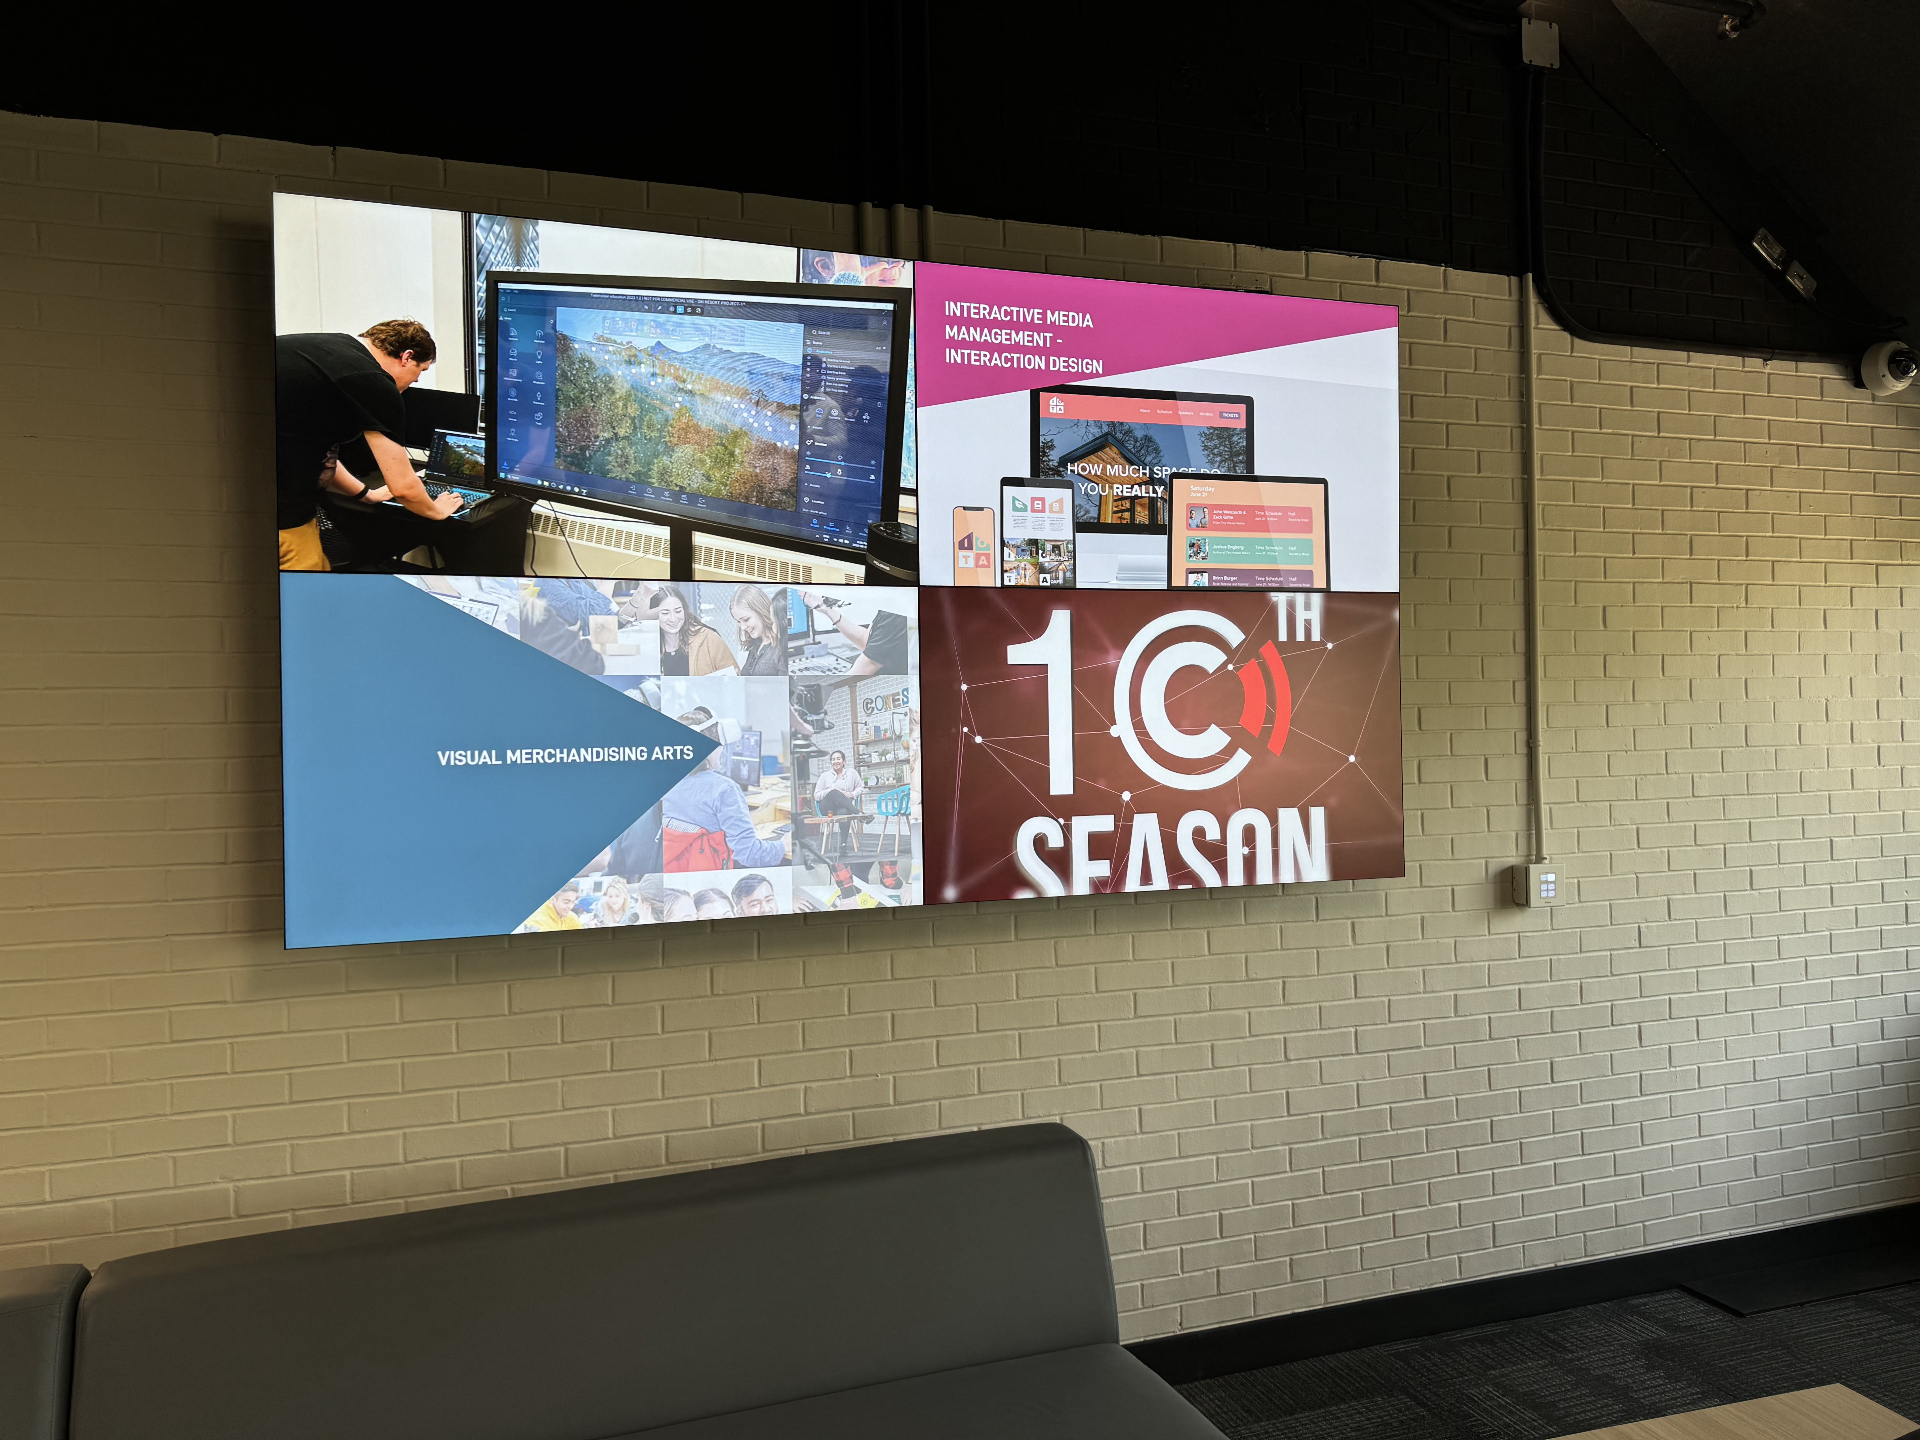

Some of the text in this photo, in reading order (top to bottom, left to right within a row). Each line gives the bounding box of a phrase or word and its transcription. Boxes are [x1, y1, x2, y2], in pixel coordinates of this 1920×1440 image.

[945, 300, 1094, 328] INTERACTIVE MEDIA
[945, 324, 1053, 348] MANAGEMENT
[945, 348, 1103, 374] INTERACTION DESIGN
[1067, 462, 1103, 476] HOW
[1106, 465, 1150, 478] MUCH
[1078, 482, 1165, 498] YOU REALLY
[1190, 485, 1215, 493] Saturday
[437, 745, 694, 766] VISUAL MERCHANDISING ARTS
[1013, 806, 1328, 899] SEASON
